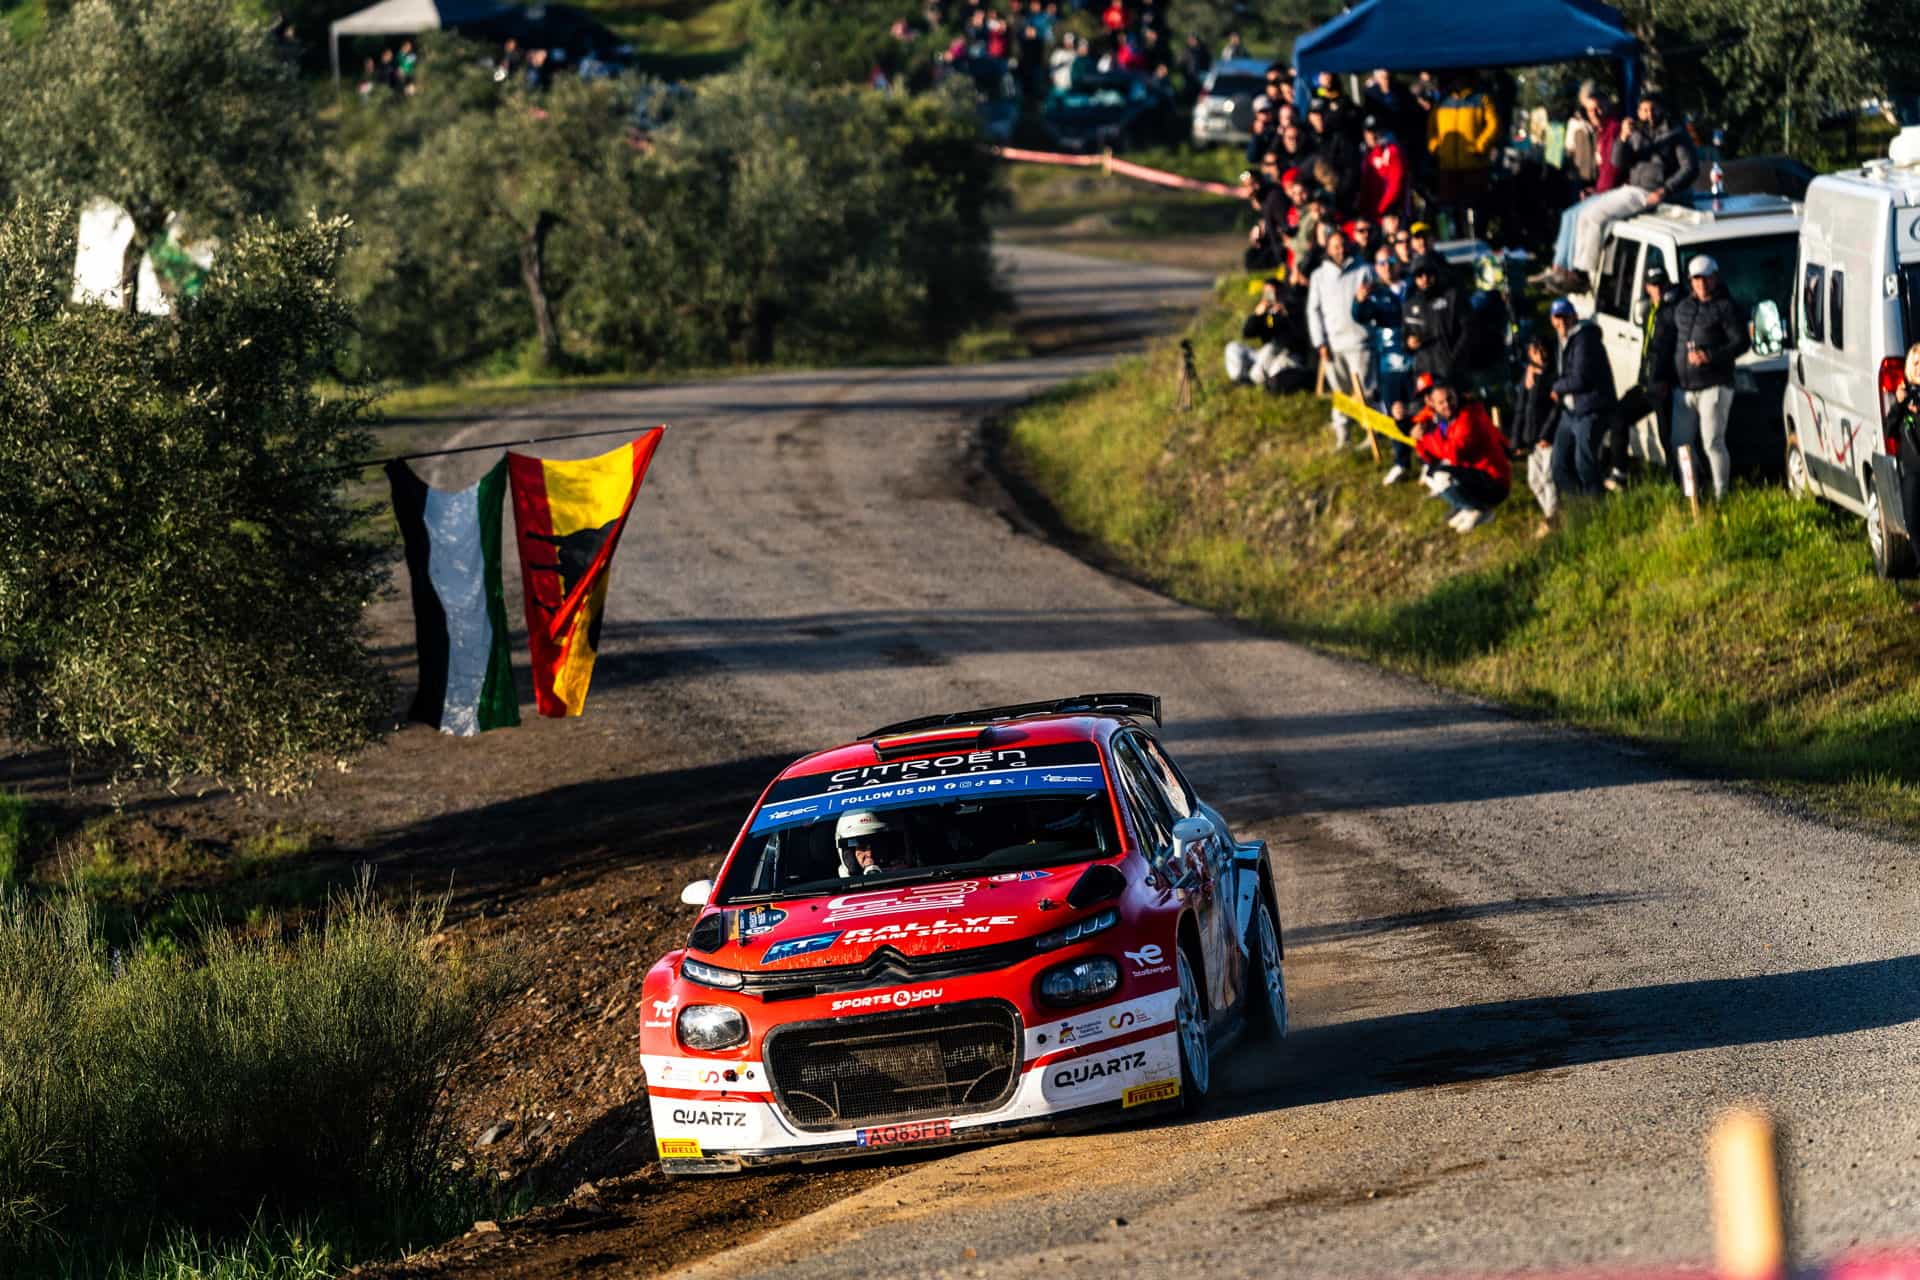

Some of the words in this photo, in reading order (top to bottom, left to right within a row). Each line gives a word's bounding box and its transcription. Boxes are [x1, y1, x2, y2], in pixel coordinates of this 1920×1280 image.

[841, 790, 893, 806] FOLLOW
[896, 786, 914, 796] US
[918, 784, 936, 794] ON
[843, 931, 908, 945] TEAM
[916, 925, 991, 938] SPAIN
[845, 915, 1018, 939] RALLYE
[1054, 1051, 1147, 1088] QUARTZ
[1127, 1082, 1175, 1105] PIRELLI
[673, 1109, 747, 1127] QUARTZ
[661, 1141, 699, 1154] PIRELLI
